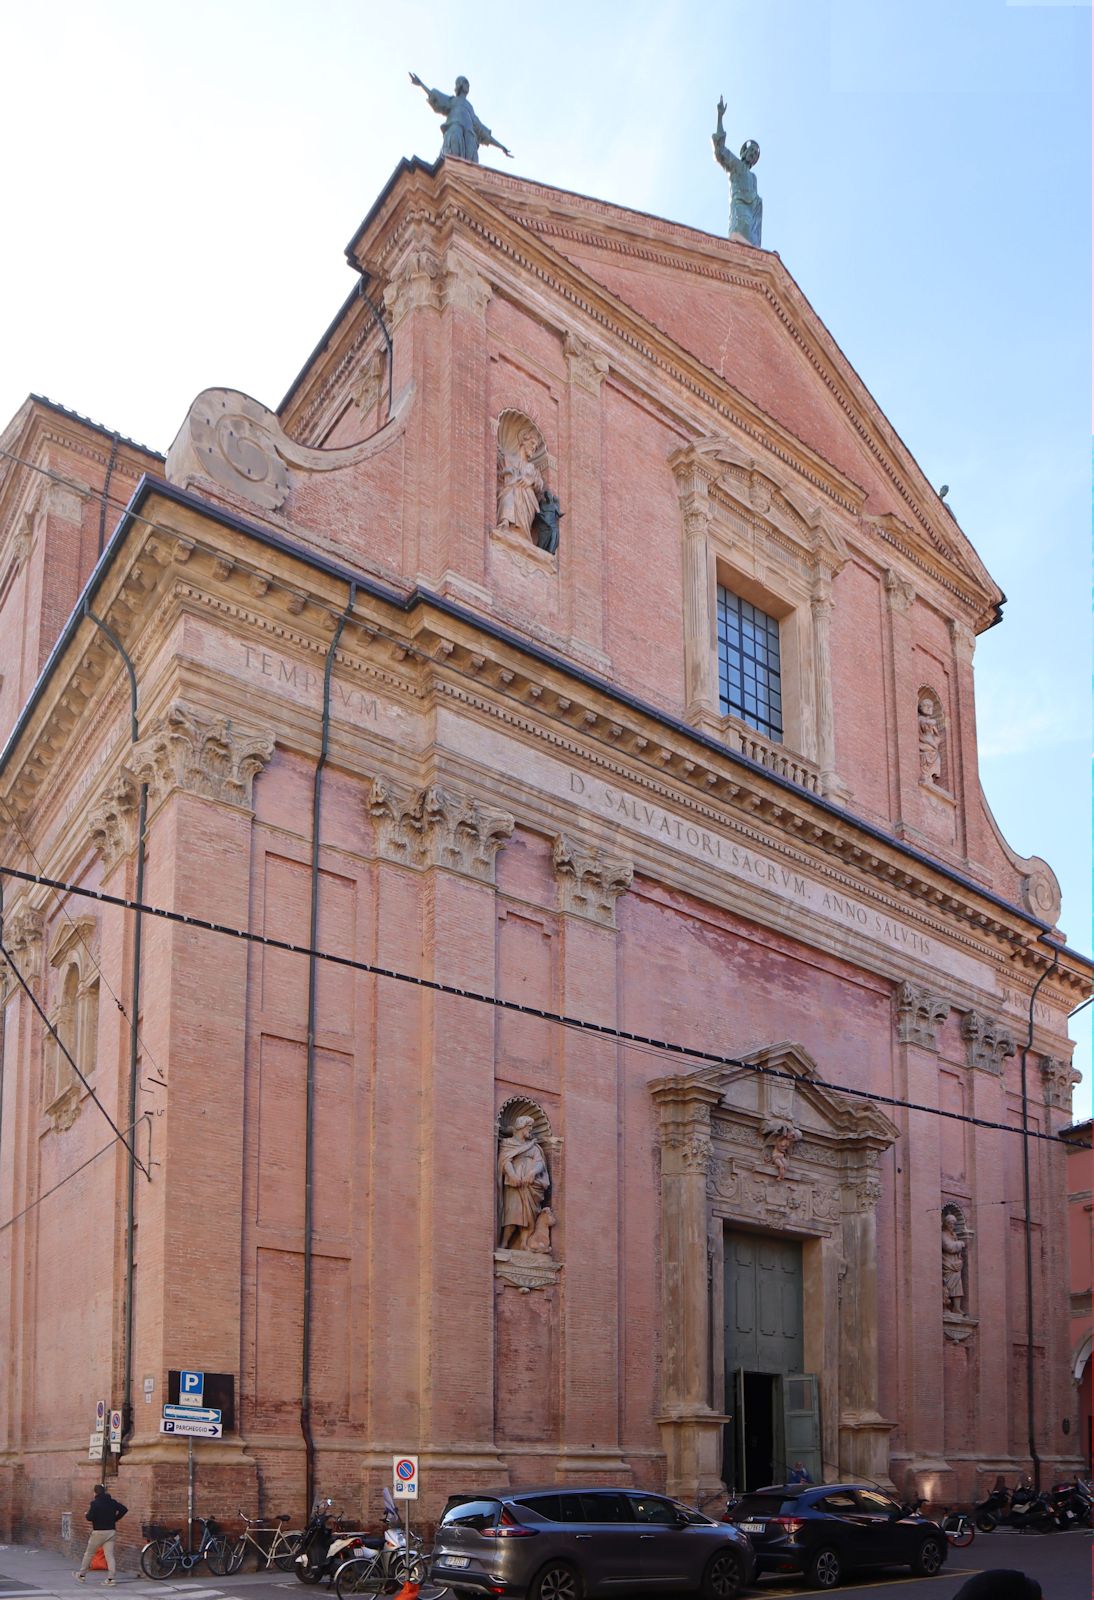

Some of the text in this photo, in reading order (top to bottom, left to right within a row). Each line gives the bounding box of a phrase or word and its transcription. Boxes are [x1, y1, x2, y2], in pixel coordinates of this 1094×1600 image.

[240, 643, 378, 721] TEMPVM
[569, 772, 592, 799] D.
[604, 789, 722, 859] SALVATORI
[731, 846, 811, 899] SACRVM.
[822, 893, 867, 925] ANNO
[874, 917, 930, 955] SALVTIS
[185, 1373, 199, 1391] P
[166, 1422, 207, 1433] P PARCHEGGIO
